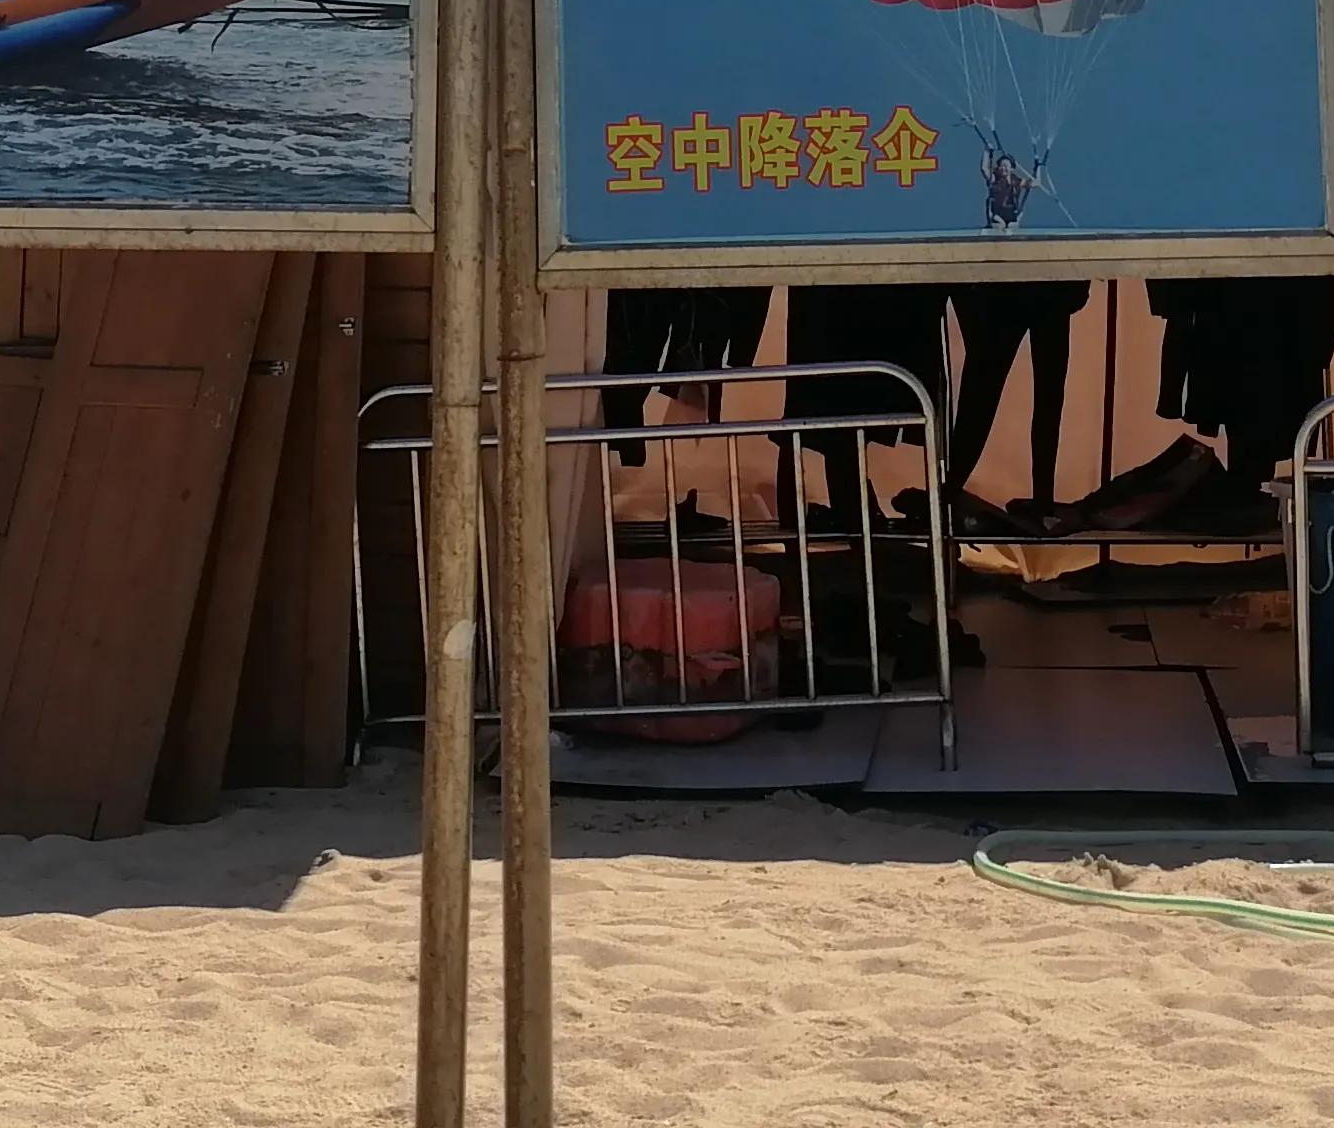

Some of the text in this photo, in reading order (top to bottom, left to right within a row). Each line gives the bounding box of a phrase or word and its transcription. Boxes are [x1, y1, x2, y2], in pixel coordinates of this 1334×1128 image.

[605, 105, 940, 192] 空中降落伞
